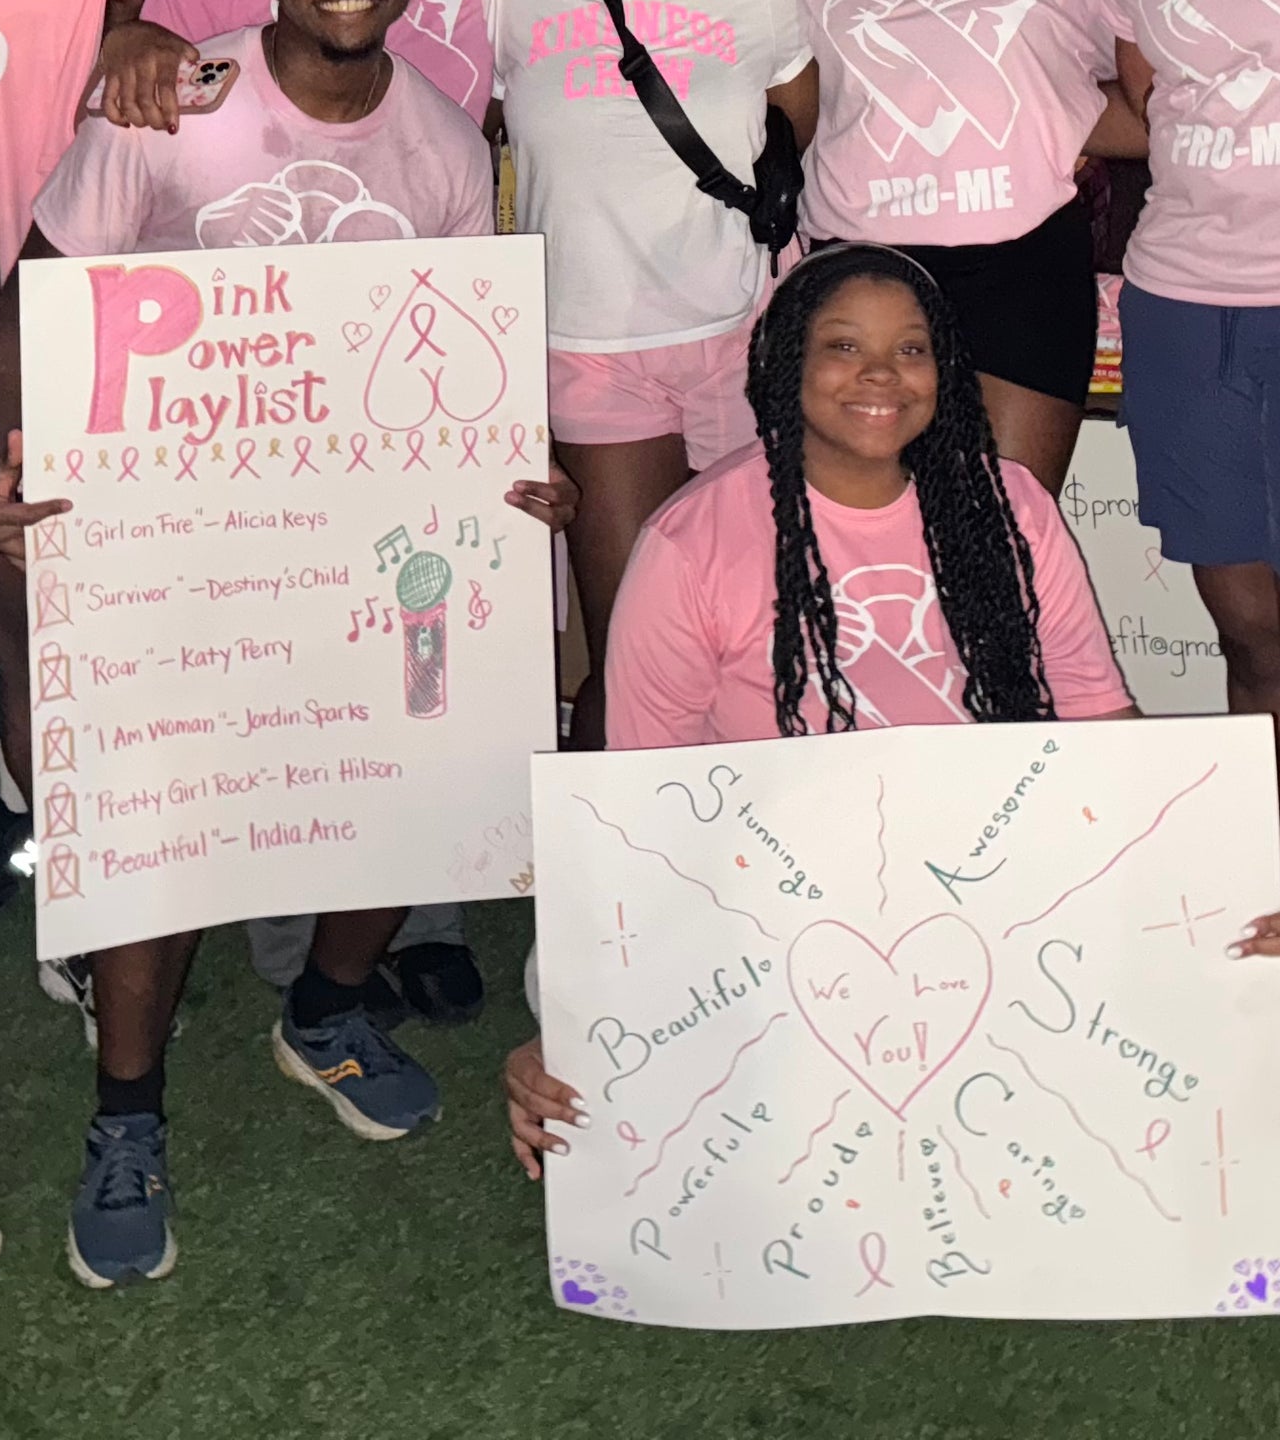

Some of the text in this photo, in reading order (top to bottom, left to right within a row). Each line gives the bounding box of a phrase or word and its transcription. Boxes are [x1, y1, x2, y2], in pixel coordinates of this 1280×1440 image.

[564, 54, 696, 100] CRW
[867, 166, 1014, 218] PRO-ME
[131, 524, 154, 539] on
[224, 510, 277, 532] Alicia
[299, 565, 349, 590] Child
[180, 646, 232, 674] Katy
[235, 637, 293, 665] Perry
[114, 727, 142, 750] Am
[235, 705, 301, 738] Jordin
[305, 699, 369, 729] Sparks
[169, 778, 207, 805] Girl
[286, 761, 329, 789] Keri
[339, 759, 402, 782] Hilson
[657, 764, 807, 897] Stunning
[924, 760, 1047, 905] Awesome
[808, 972, 970, 1000] We Love
[587, 955, 762, 1103] Beautiful
[853, 1014, 928, 1072] You!
[1008, 939, 1190, 1102] Strong
[954, 1072, 1070, 1225] Caring
[630, 1112, 753, 1261] Powerful
[762, 1142, 859, 1279] Proud
